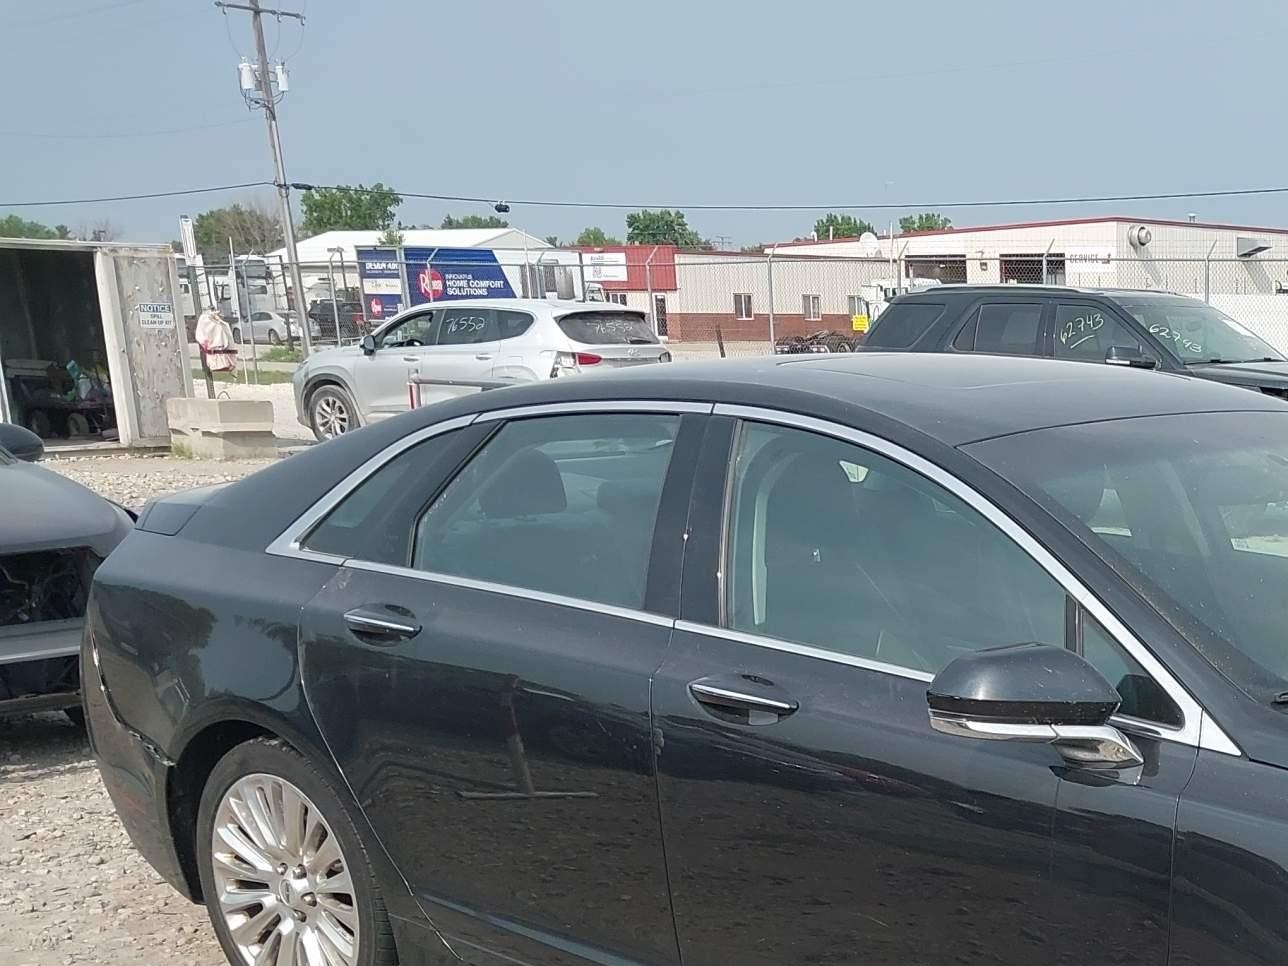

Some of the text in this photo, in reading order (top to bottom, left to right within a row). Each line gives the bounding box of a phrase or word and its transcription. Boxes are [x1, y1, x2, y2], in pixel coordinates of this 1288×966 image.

[1069, 254, 1099, 264] SERVICE
[446, 280, 504, 289] HOME COMFORT
[447, 287, 488, 296] SOLUTIONS
[141, 304, 170, 313] NOTICE
[445, 316, 487, 334] 76552
[1060, 313, 1104, 345] 62743
[1150, 323, 1202, 353] 62743
